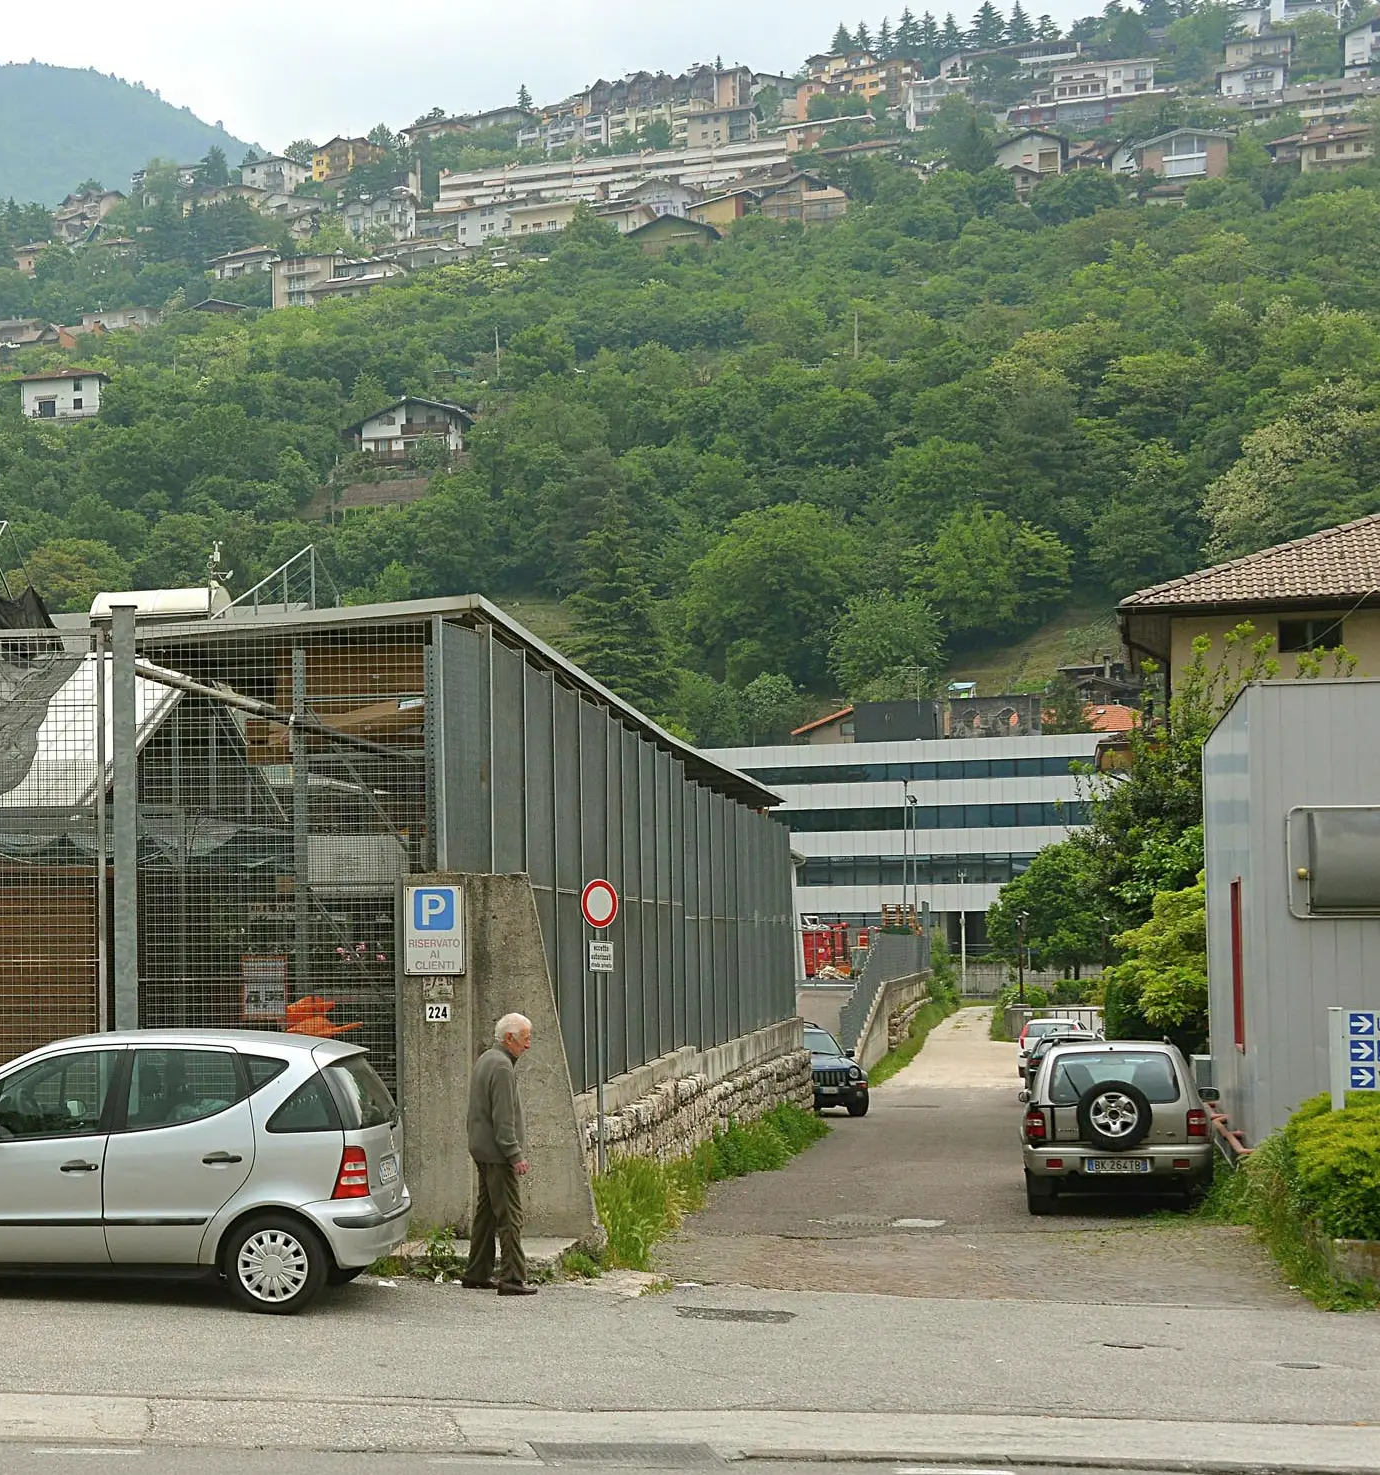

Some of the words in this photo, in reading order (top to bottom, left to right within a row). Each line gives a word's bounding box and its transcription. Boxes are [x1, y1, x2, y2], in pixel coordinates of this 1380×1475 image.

[421, 894, 446, 926] P
[408, 939, 460, 948] RISERVATO
[430, 951, 440, 959] AI
[415, 961, 455, 970] CLIENTI
[428, 1006, 448, 1019] 224
